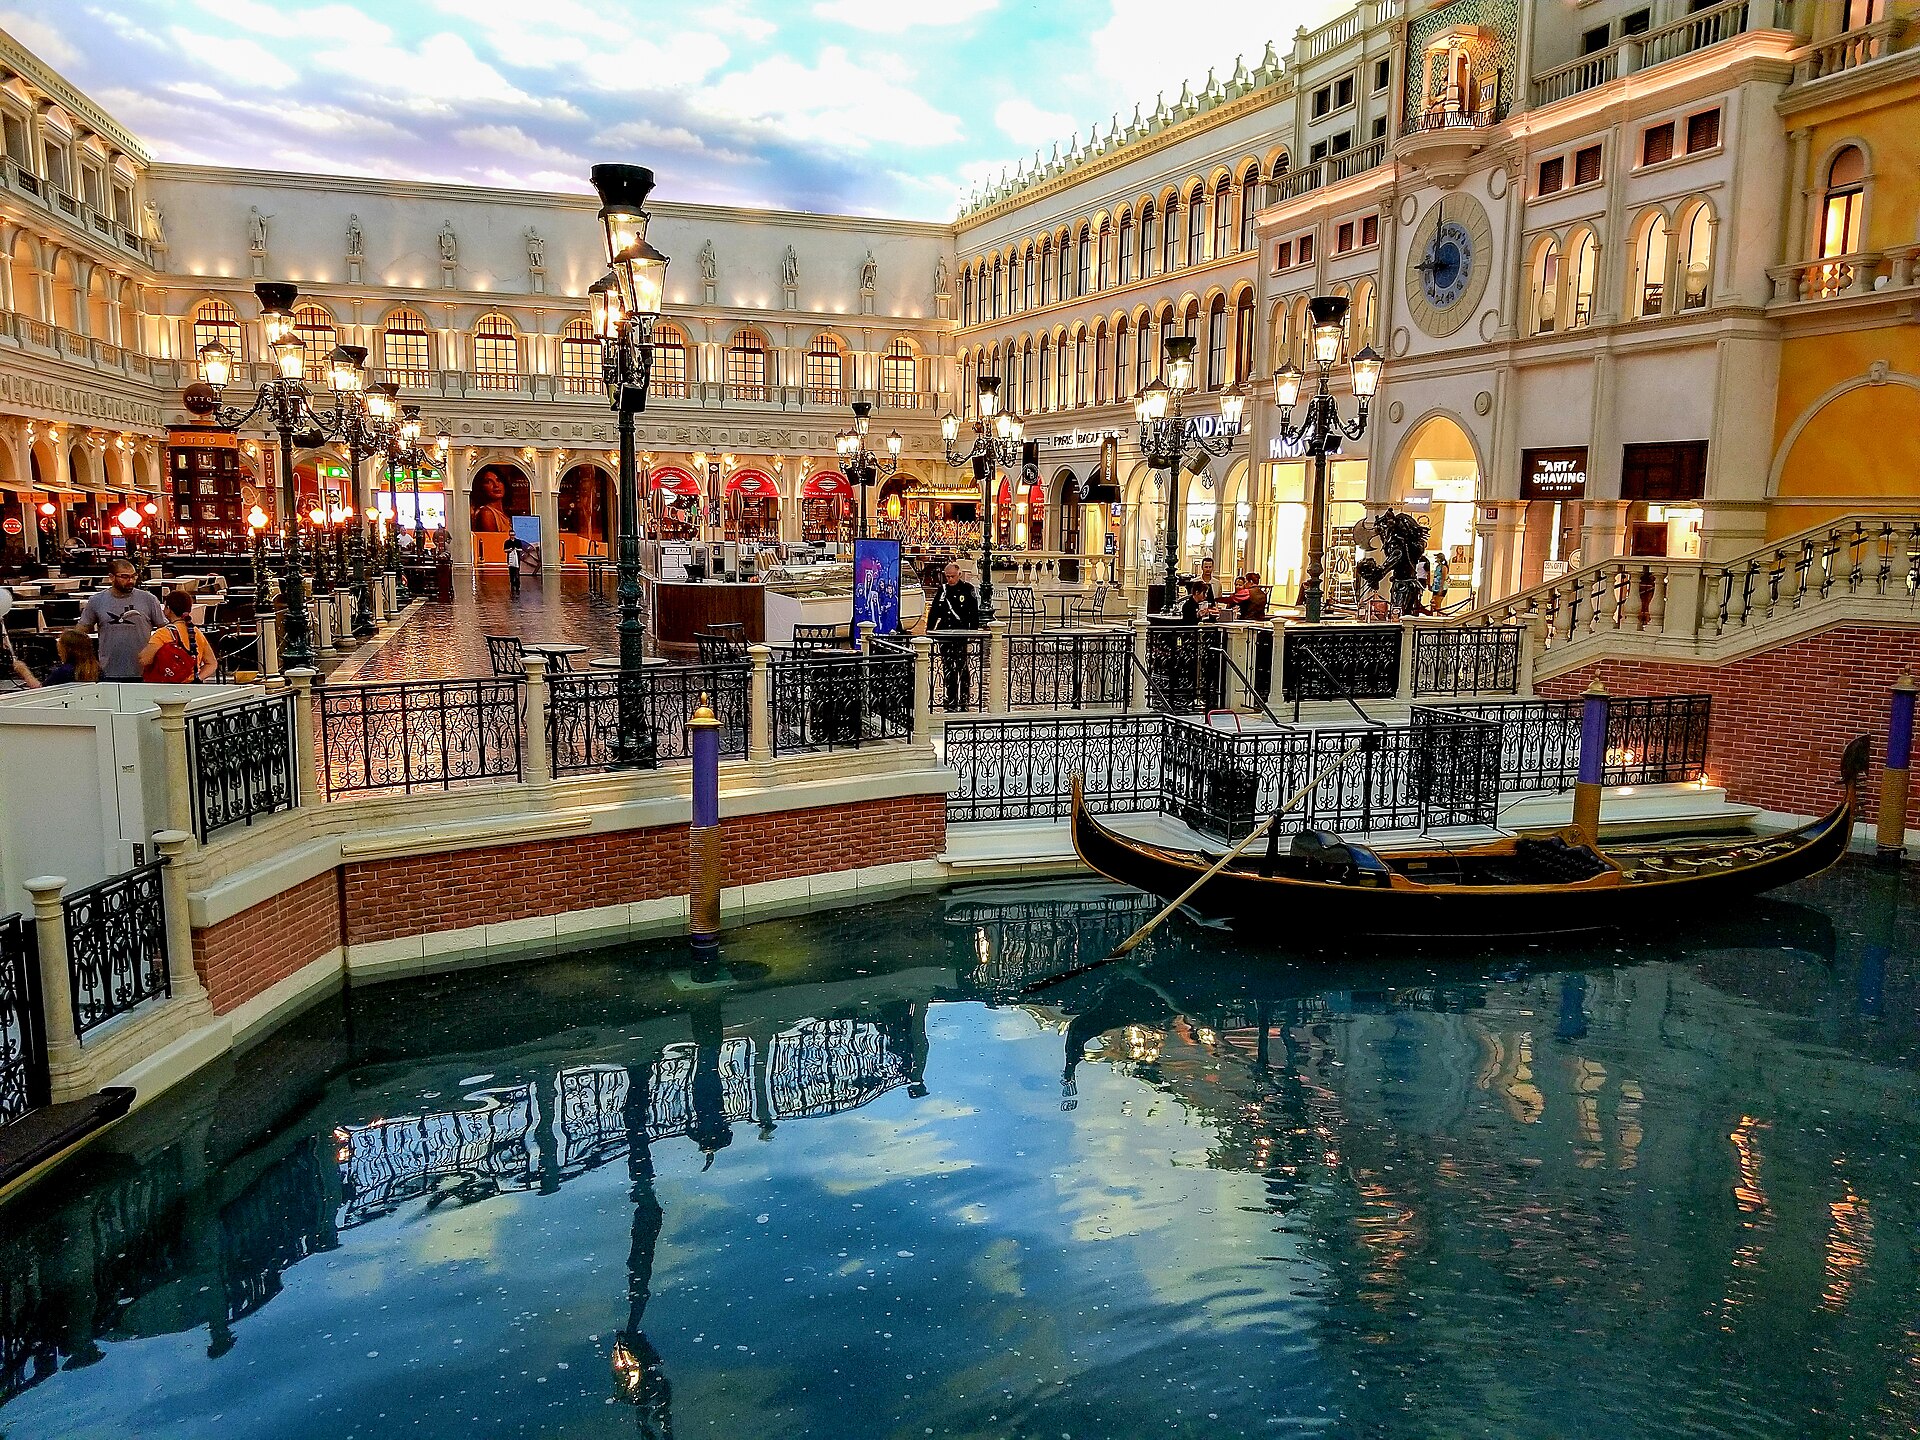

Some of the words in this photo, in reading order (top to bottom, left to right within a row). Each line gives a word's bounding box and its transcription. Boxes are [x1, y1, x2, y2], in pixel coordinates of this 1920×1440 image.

[1480, 83, 1494, 103] XII
[179, 435, 217, 444] OTTO
[1053, 435, 1074, 447] PARIS
[265, 453, 274, 484] OTTO
[1544, 461, 1570, 473] ART
[1532, 472, 1586, 484] SHAVING
